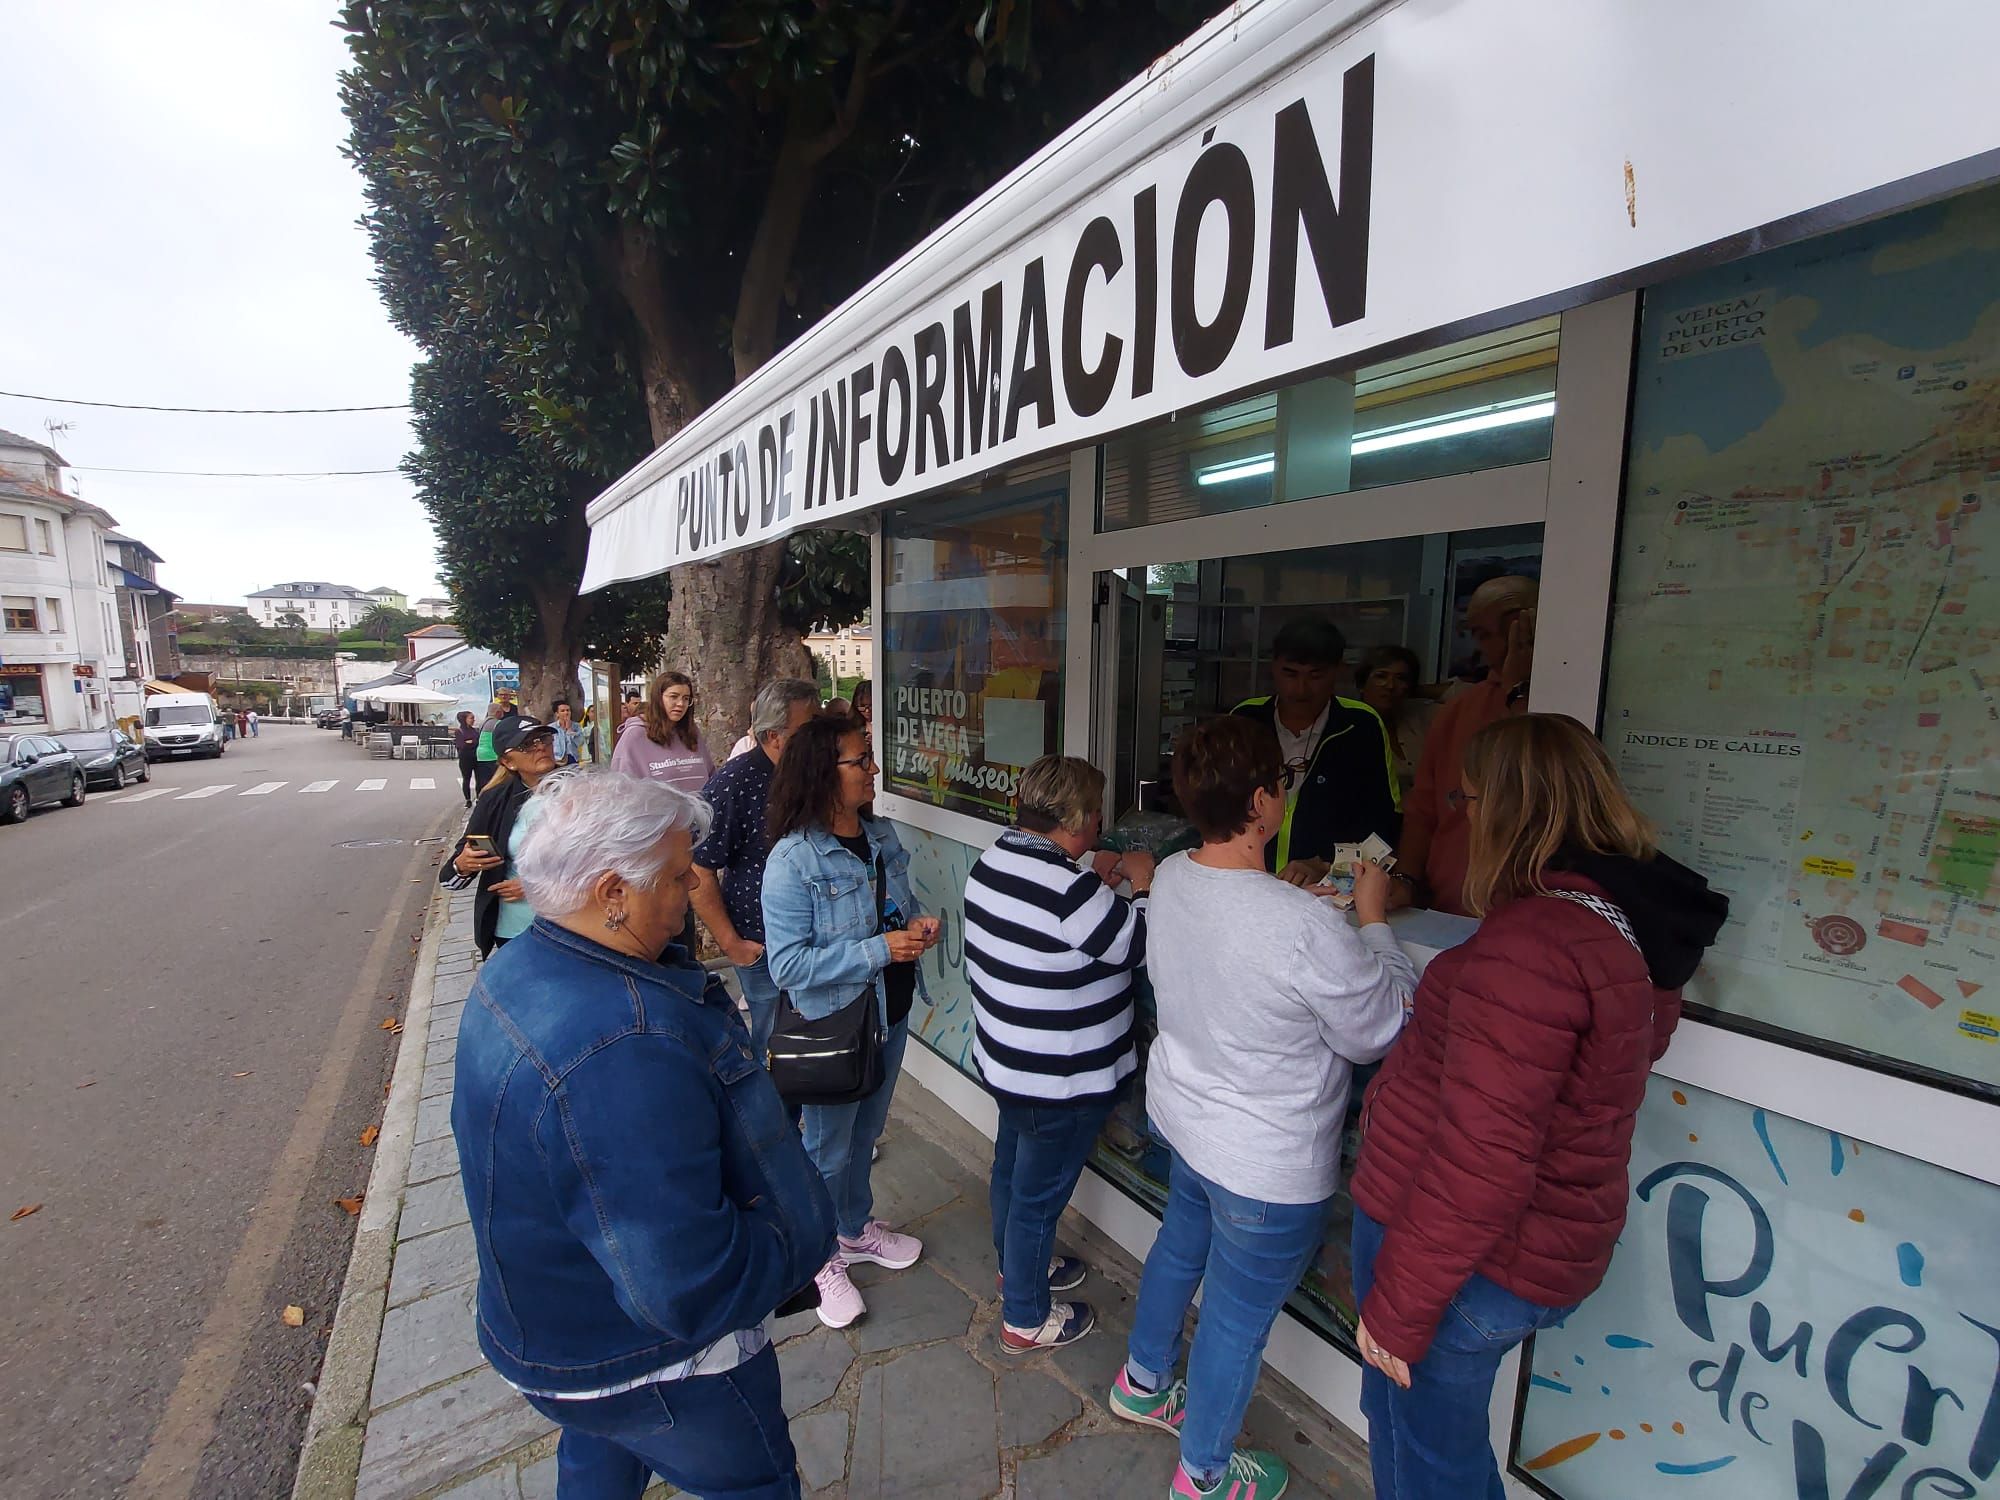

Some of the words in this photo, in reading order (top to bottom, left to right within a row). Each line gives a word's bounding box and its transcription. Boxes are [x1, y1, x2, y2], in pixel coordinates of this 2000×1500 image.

[675, 447, 750, 555] PUNTO
[758, 408, 796, 530] DE
[802, 52, 1377, 511] INFORMACIÓN
[1675, 294, 1761, 325] VEIGA/
[1667, 311, 1766, 341] PUERTO
[1662, 343, 1693, 358] DE
[1697, 326, 1768, 349] VEGA
[431, 673, 466, 691] Puerto
[897, 686, 966, 719] PUERTO
[1622, 710, 1630, 718] 3
[897, 716, 918, 746] DE
[922, 719, 970, 757] VEGA
[1624, 731, 1689, 748] ÍNDICE
[1694, 738, 1720, 750] DE
[1725, 741, 1802, 757] CALLES
[648, 757, 678, 771] Studio
[896, 747, 907, 773] y
[910, 752, 939, 777] sus
[944, 759, 1020, 797] museos
[1688, 1342, 1772, 1446] de
